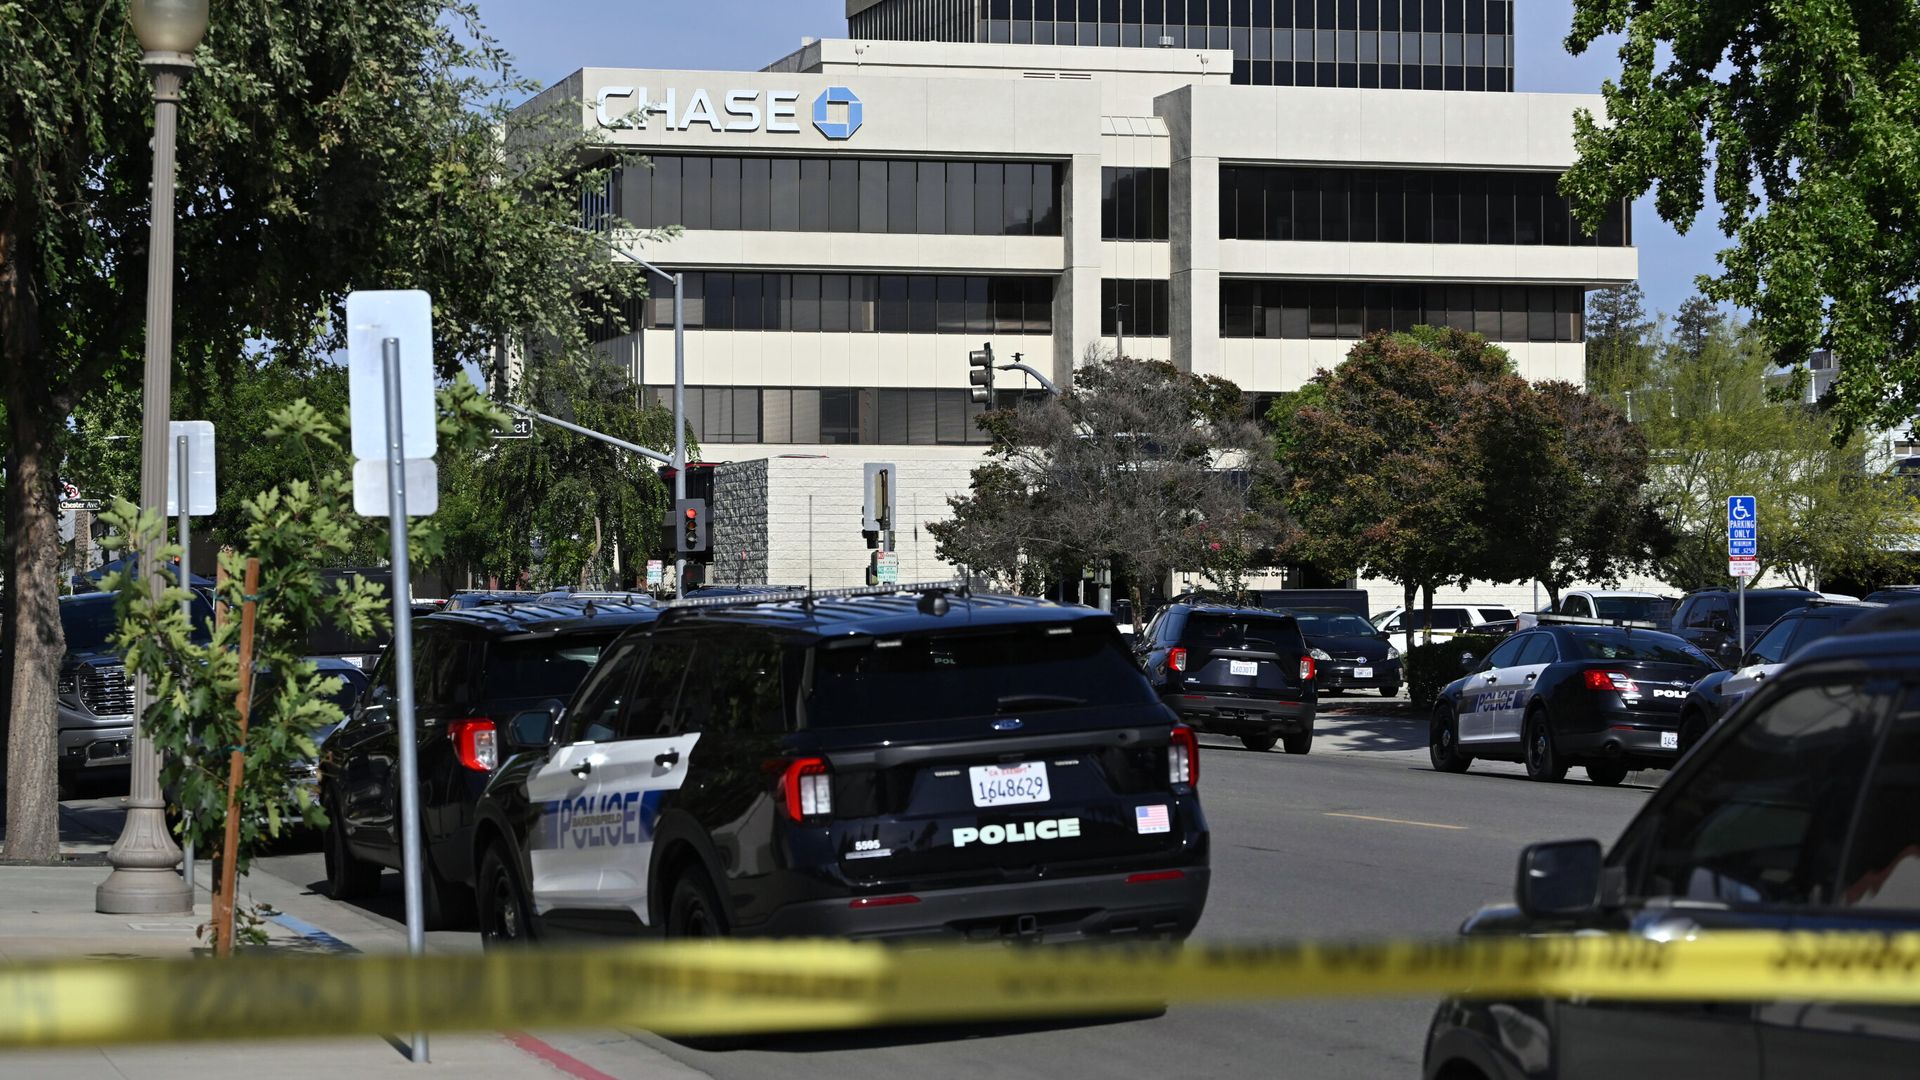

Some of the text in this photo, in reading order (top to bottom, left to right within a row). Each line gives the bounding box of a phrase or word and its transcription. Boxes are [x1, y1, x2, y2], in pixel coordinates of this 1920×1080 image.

[596, 86, 801, 133] CHASE
[61, 501, 85, 509] Chester
[1730, 520, 1755, 529] PARKING
[1734, 529, 1751, 538] ONLY
[1476, 690, 1515, 713] POLICE
[1002, 767, 1028, 776] EXEMPT
[979, 776, 1043, 800] 1648629
[559, 791, 640, 849] POLICE
[572, 813, 622, 828] BAKERSFIELD
[952, 817, 1081, 848] POLICE
